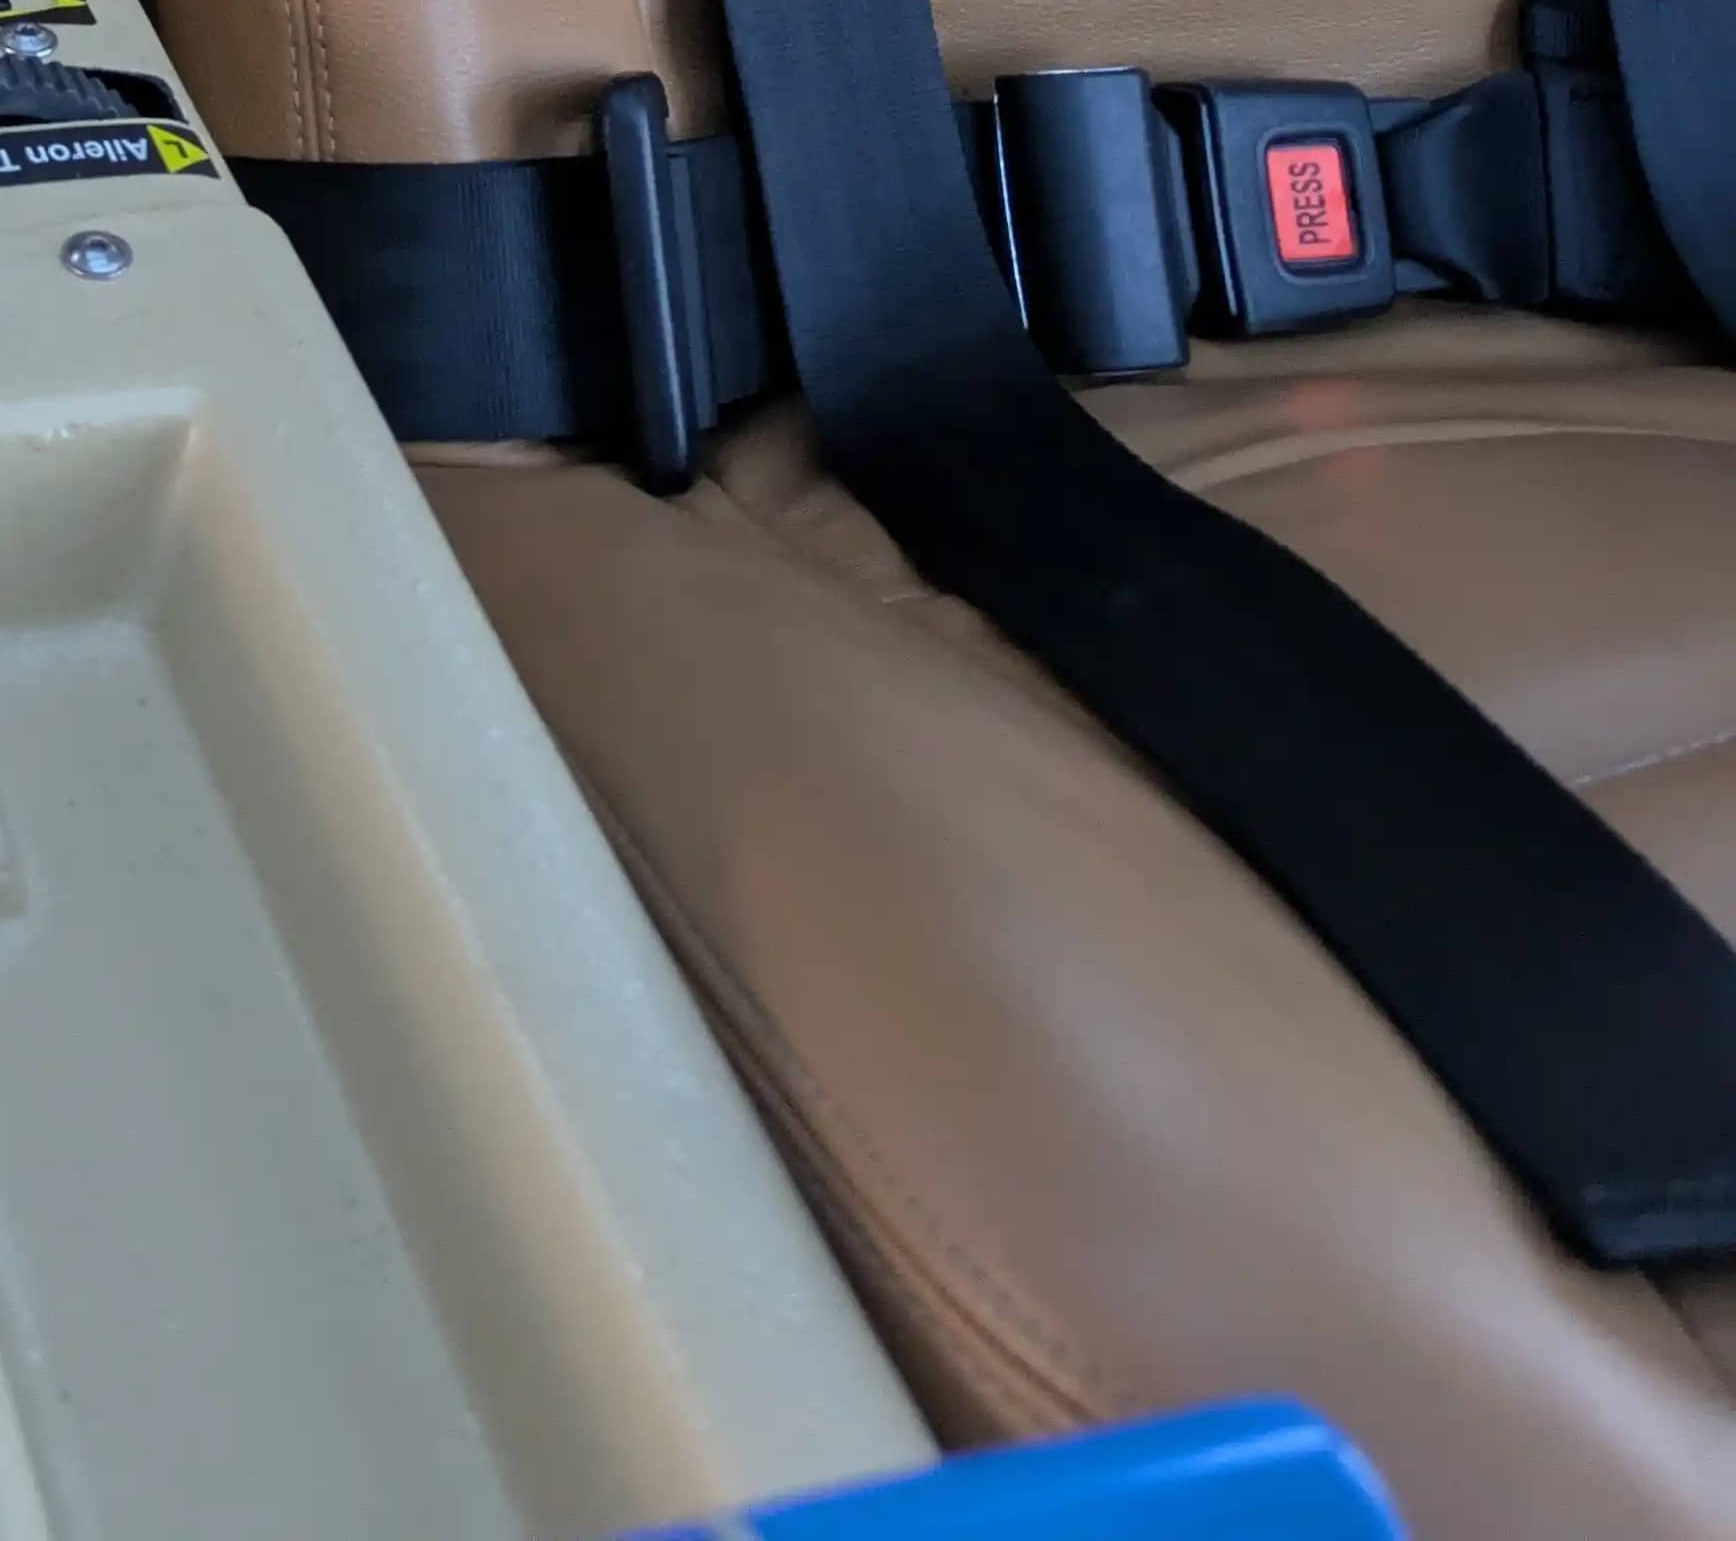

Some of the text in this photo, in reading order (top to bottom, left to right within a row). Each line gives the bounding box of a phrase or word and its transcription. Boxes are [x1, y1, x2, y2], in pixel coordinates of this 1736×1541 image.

[24, 137, 148, 163] Aileron
[164, 139, 189, 159] L
[1288, 161, 1331, 246] PRESS
